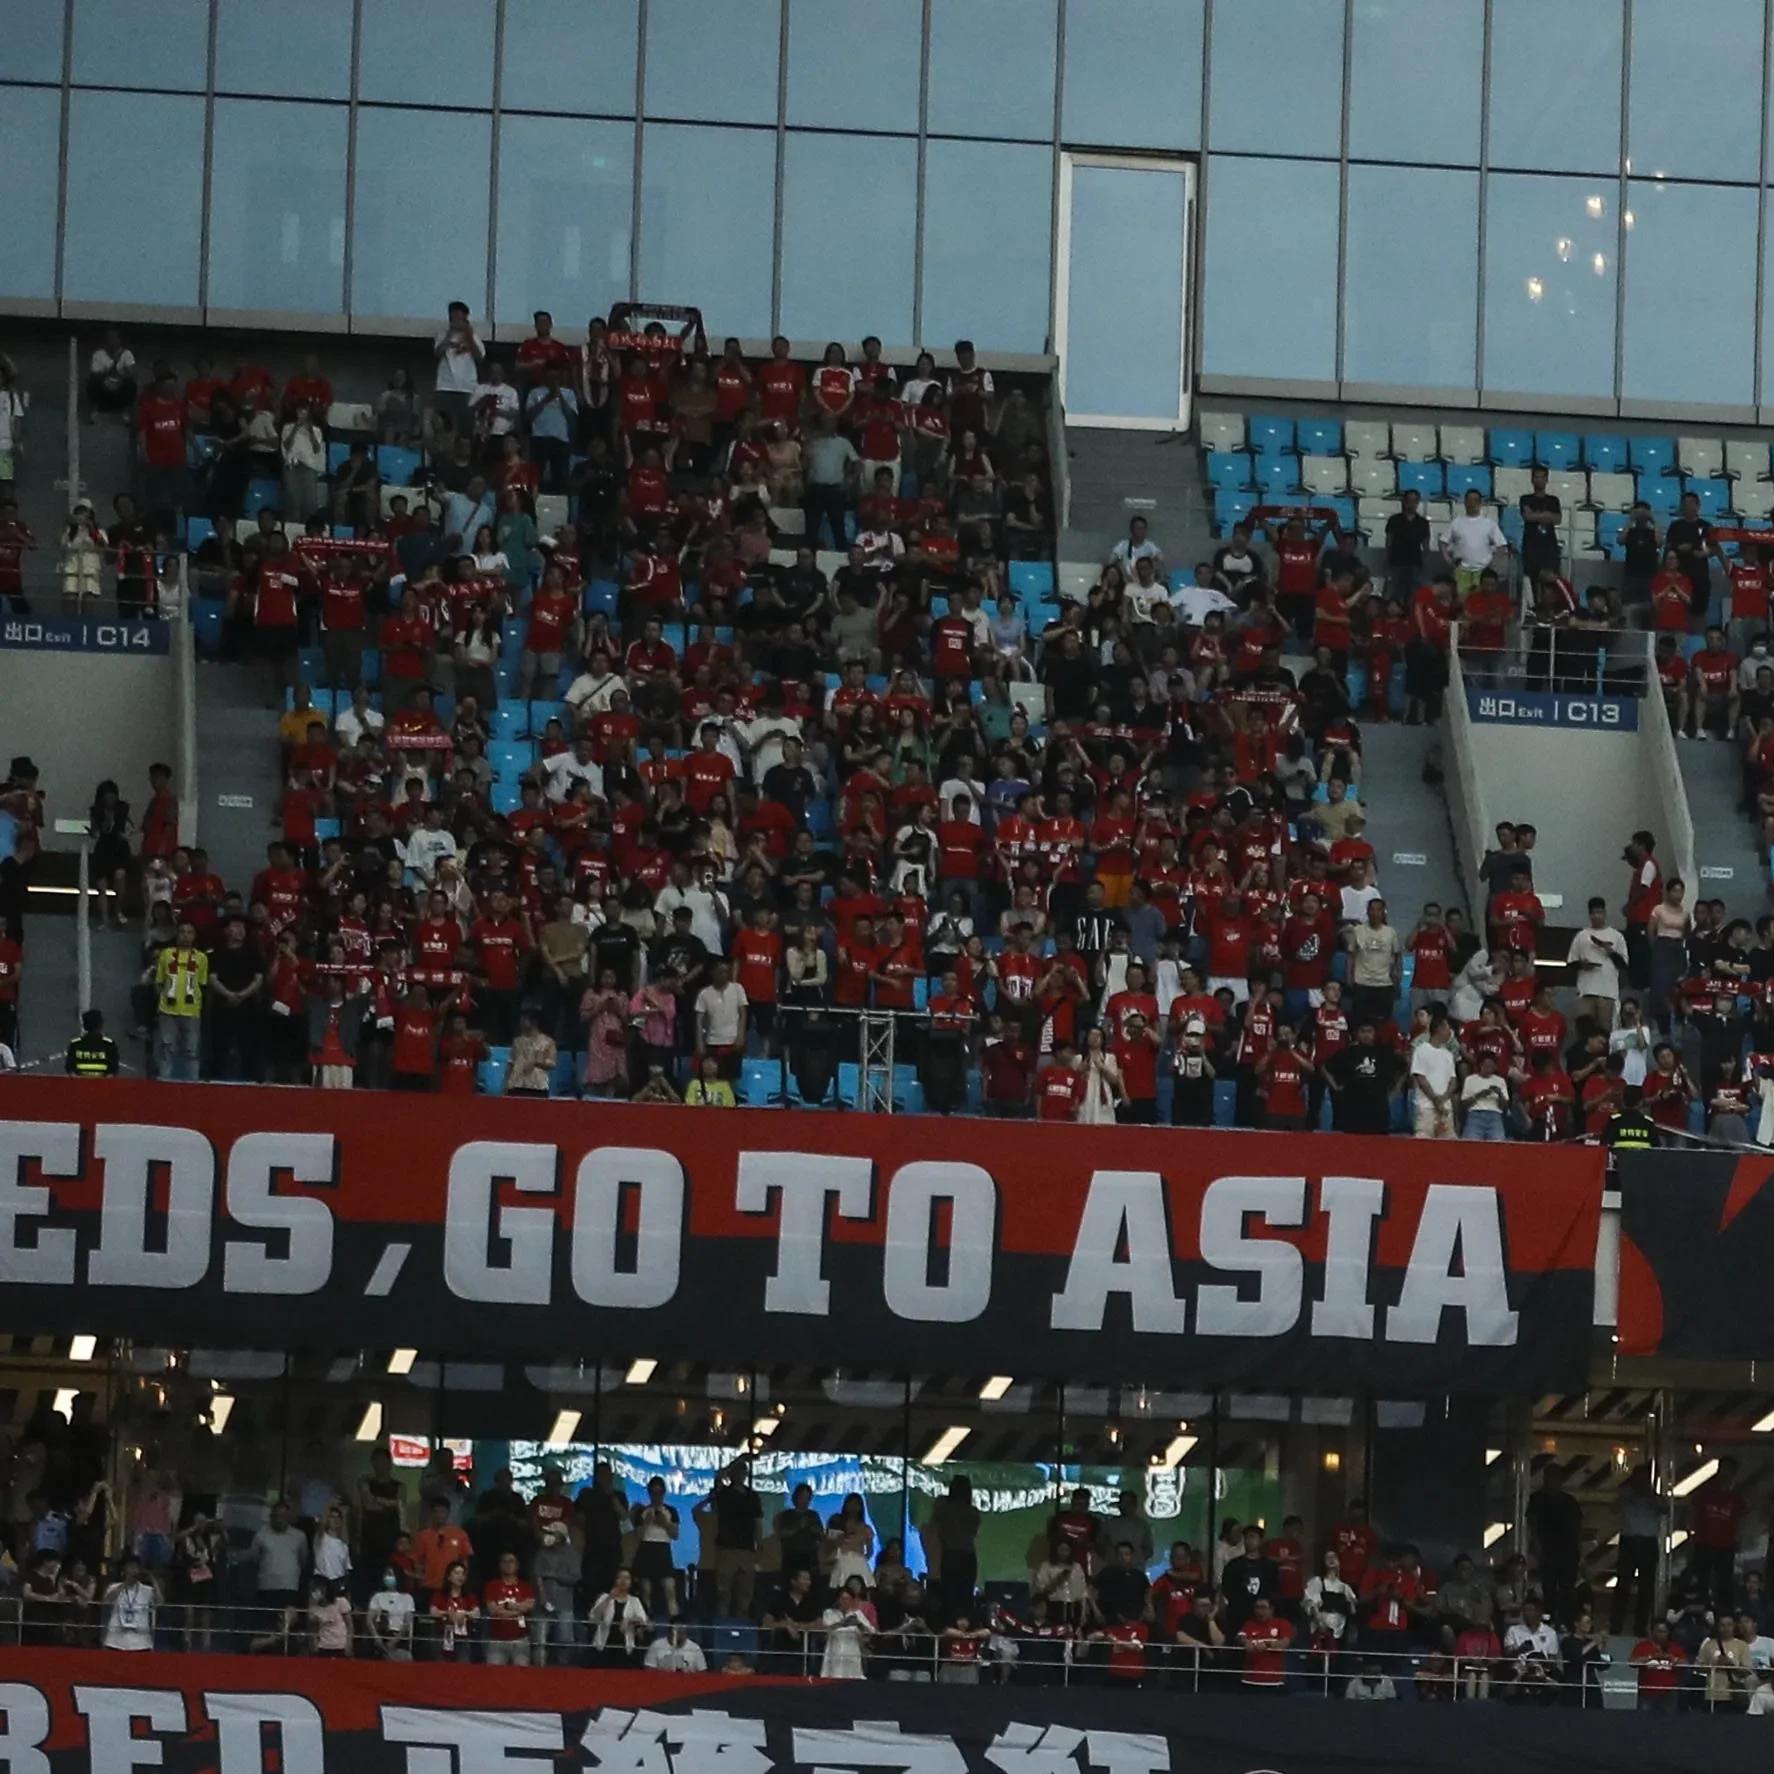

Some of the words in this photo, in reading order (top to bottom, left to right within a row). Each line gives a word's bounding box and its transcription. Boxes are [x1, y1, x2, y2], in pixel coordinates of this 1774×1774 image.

[5, 622, 42, 642] 出口
[45, 631, 71, 643] Exit
[97, 627, 150, 647] C14
[1479, 697, 1515, 717] 出口
[1518, 707, 1543, 719] Exit
[1568, 703, 1619, 723] C13
[444, 1141, 685, 1309] GO
[736, 1150, 997, 1324] TO
[1050, 1168, 1520, 1348] ASIA
